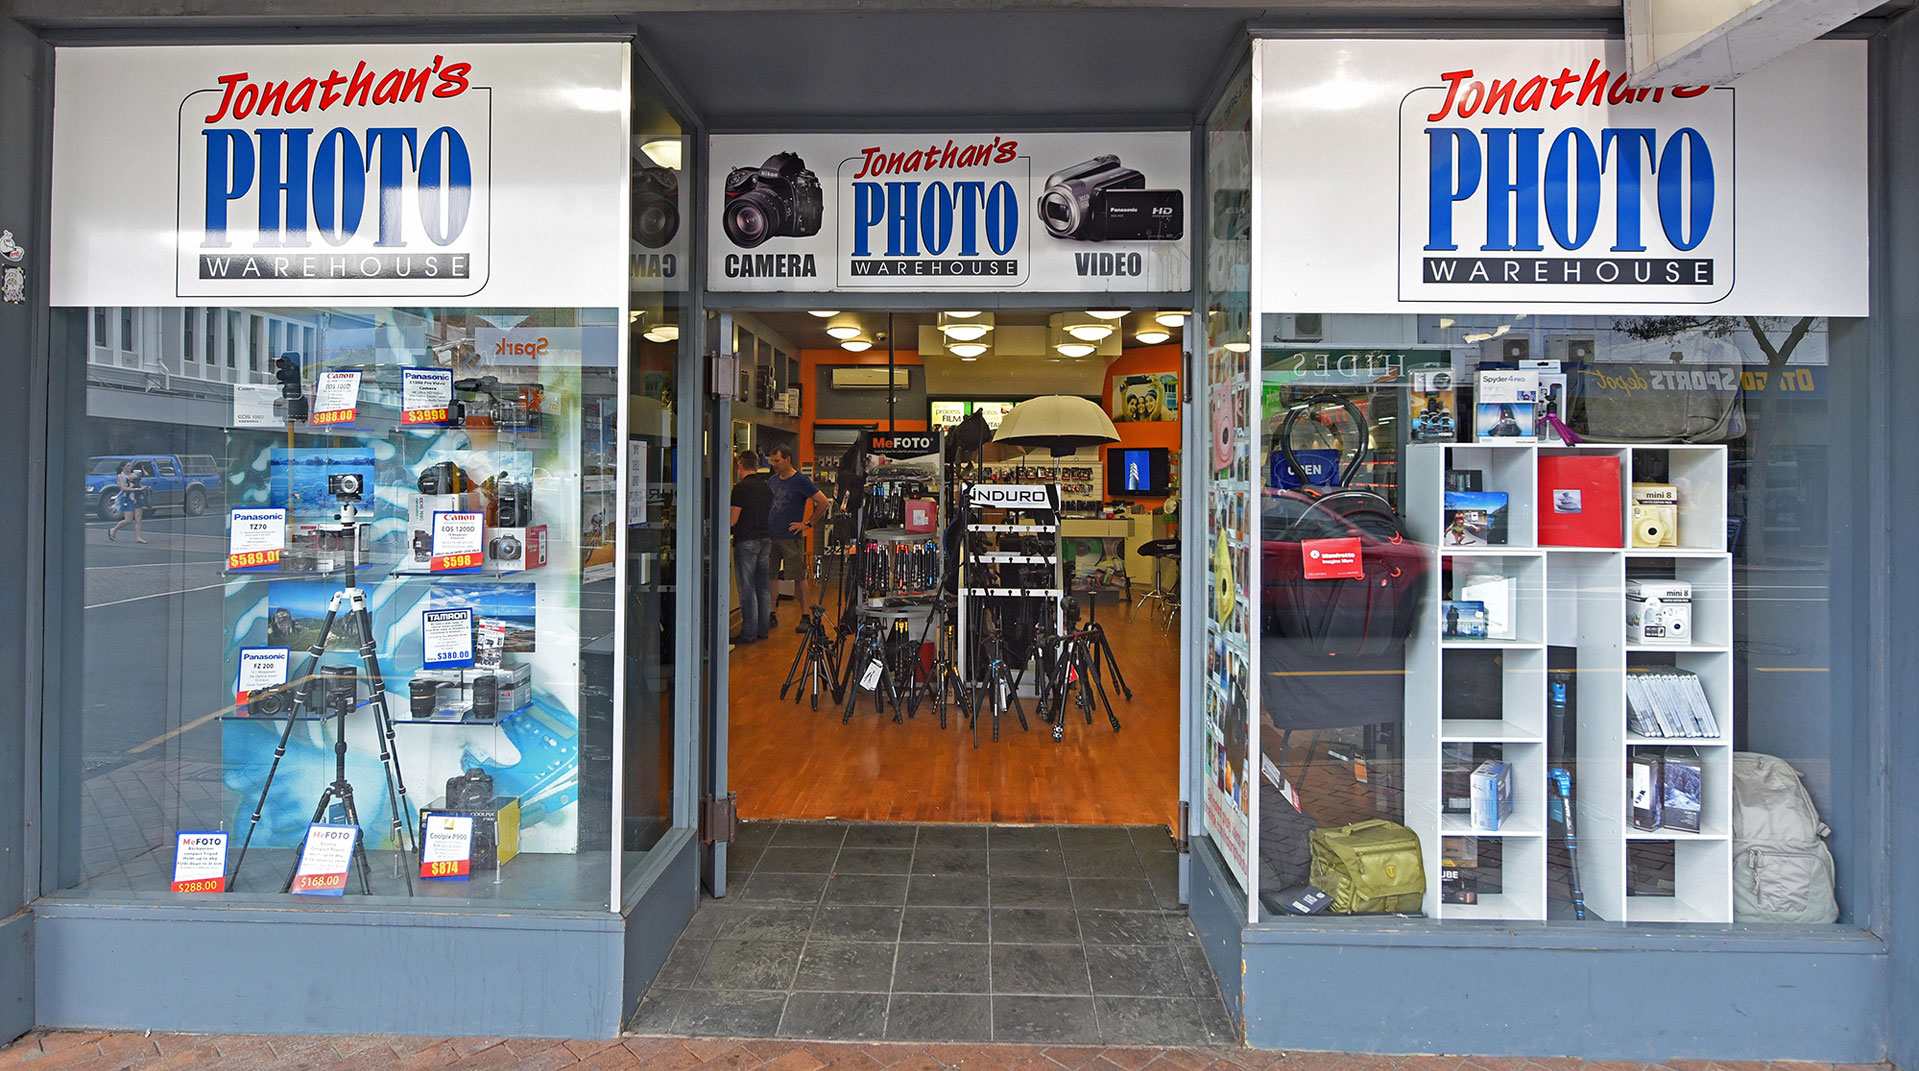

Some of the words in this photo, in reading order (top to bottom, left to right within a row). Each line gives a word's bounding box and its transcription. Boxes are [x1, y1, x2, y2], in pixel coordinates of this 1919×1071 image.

[204, 54, 472, 124] Jonathan's
[1427, 58, 1711, 122] Jonatha
[853, 136, 1018, 180] Jonathan's
[761, 170, 778, 178] Nikon
[202, 126, 472, 248] PHOTO
[1423, 127, 1715, 252] PHOTO
[1152, 207, 1173, 215] HD
[851, 180, 1019, 258] PHOTO
[206, 256, 465, 278] WAREHOUSE
[724, 254, 817, 278] CAMERA
[853, 261, 1017, 276] WAREHOUSE
[1074, 252, 1142, 276] VIDEO
[1430, 260, 1709, 282] WAREHOUSE
[405, 372, 450, 381] Panasonic
[313, 410, 352, 424] $988.00
[408, 408, 447, 422] $3998
[872, 437, 931, 449] MeFOTO
[1646, 491, 1665, 499] mini
[1666, 491, 1672, 499] 8
[233, 512, 283, 521] Panasonic
[443, 555, 472, 569] $598
[1666, 589, 1683, 597] mini
[1683, 589, 1689, 597] 8
[428, 612, 467, 622] TAMRON
[243, 652, 286, 660] Panasonic
[437, 650, 470, 661] $380.00
[183, 838, 222, 846] MeFOTO
[313, 831, 350, 840] MeFOTO
[429, 832, 451, 840] Coolpix
[431, 861, 459, 876] $874
[178, 880, 217, 893] $288.00
[300, 875, 339, 888] $168.00
